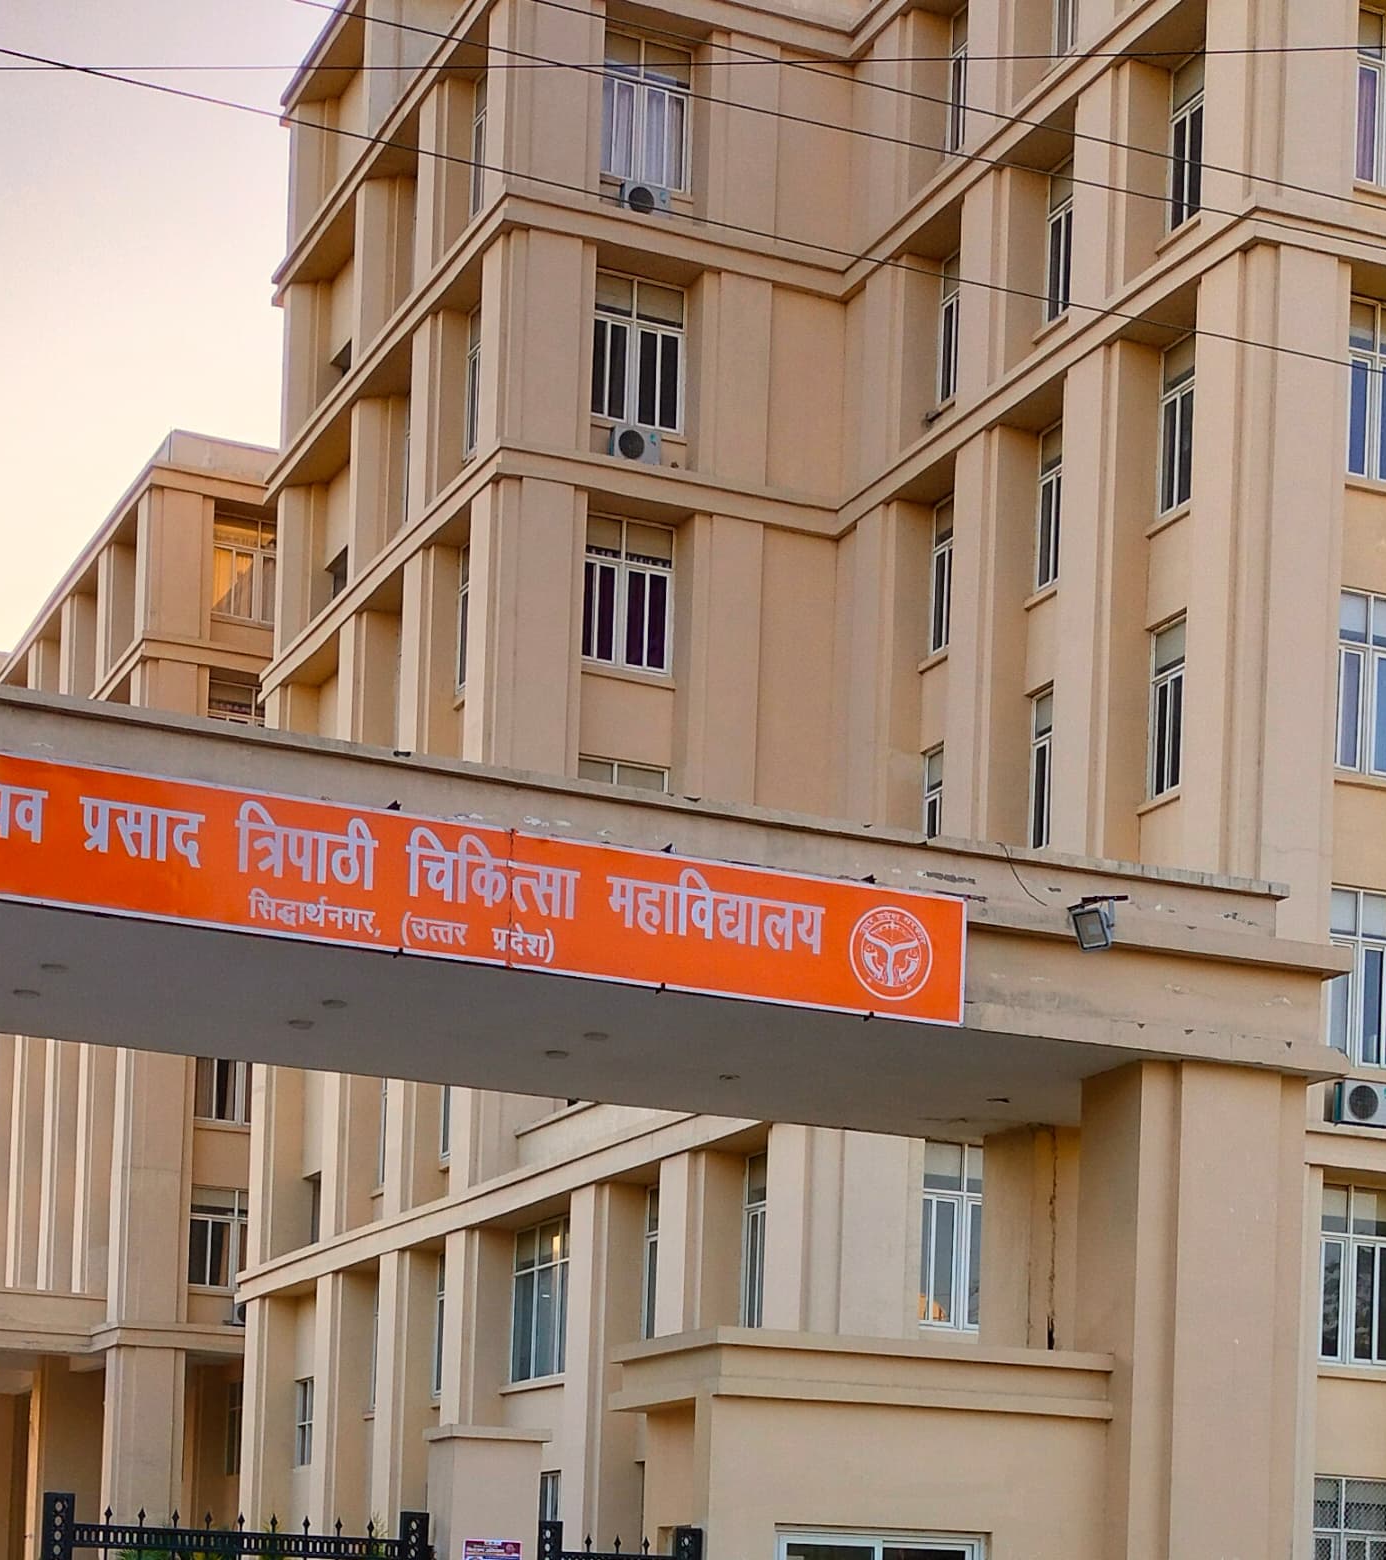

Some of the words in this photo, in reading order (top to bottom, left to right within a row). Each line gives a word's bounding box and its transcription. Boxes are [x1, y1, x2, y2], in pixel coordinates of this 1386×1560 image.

[79, 795, 205, 869] प्रसाद
[235, 800, 379, 891] त्रिपाठी
[406, 826, 581, 920] चिकित्सा
[606, 868, 826, 955] महाविद्यालय
[491, 923, 556, 963] प्रदेश)
